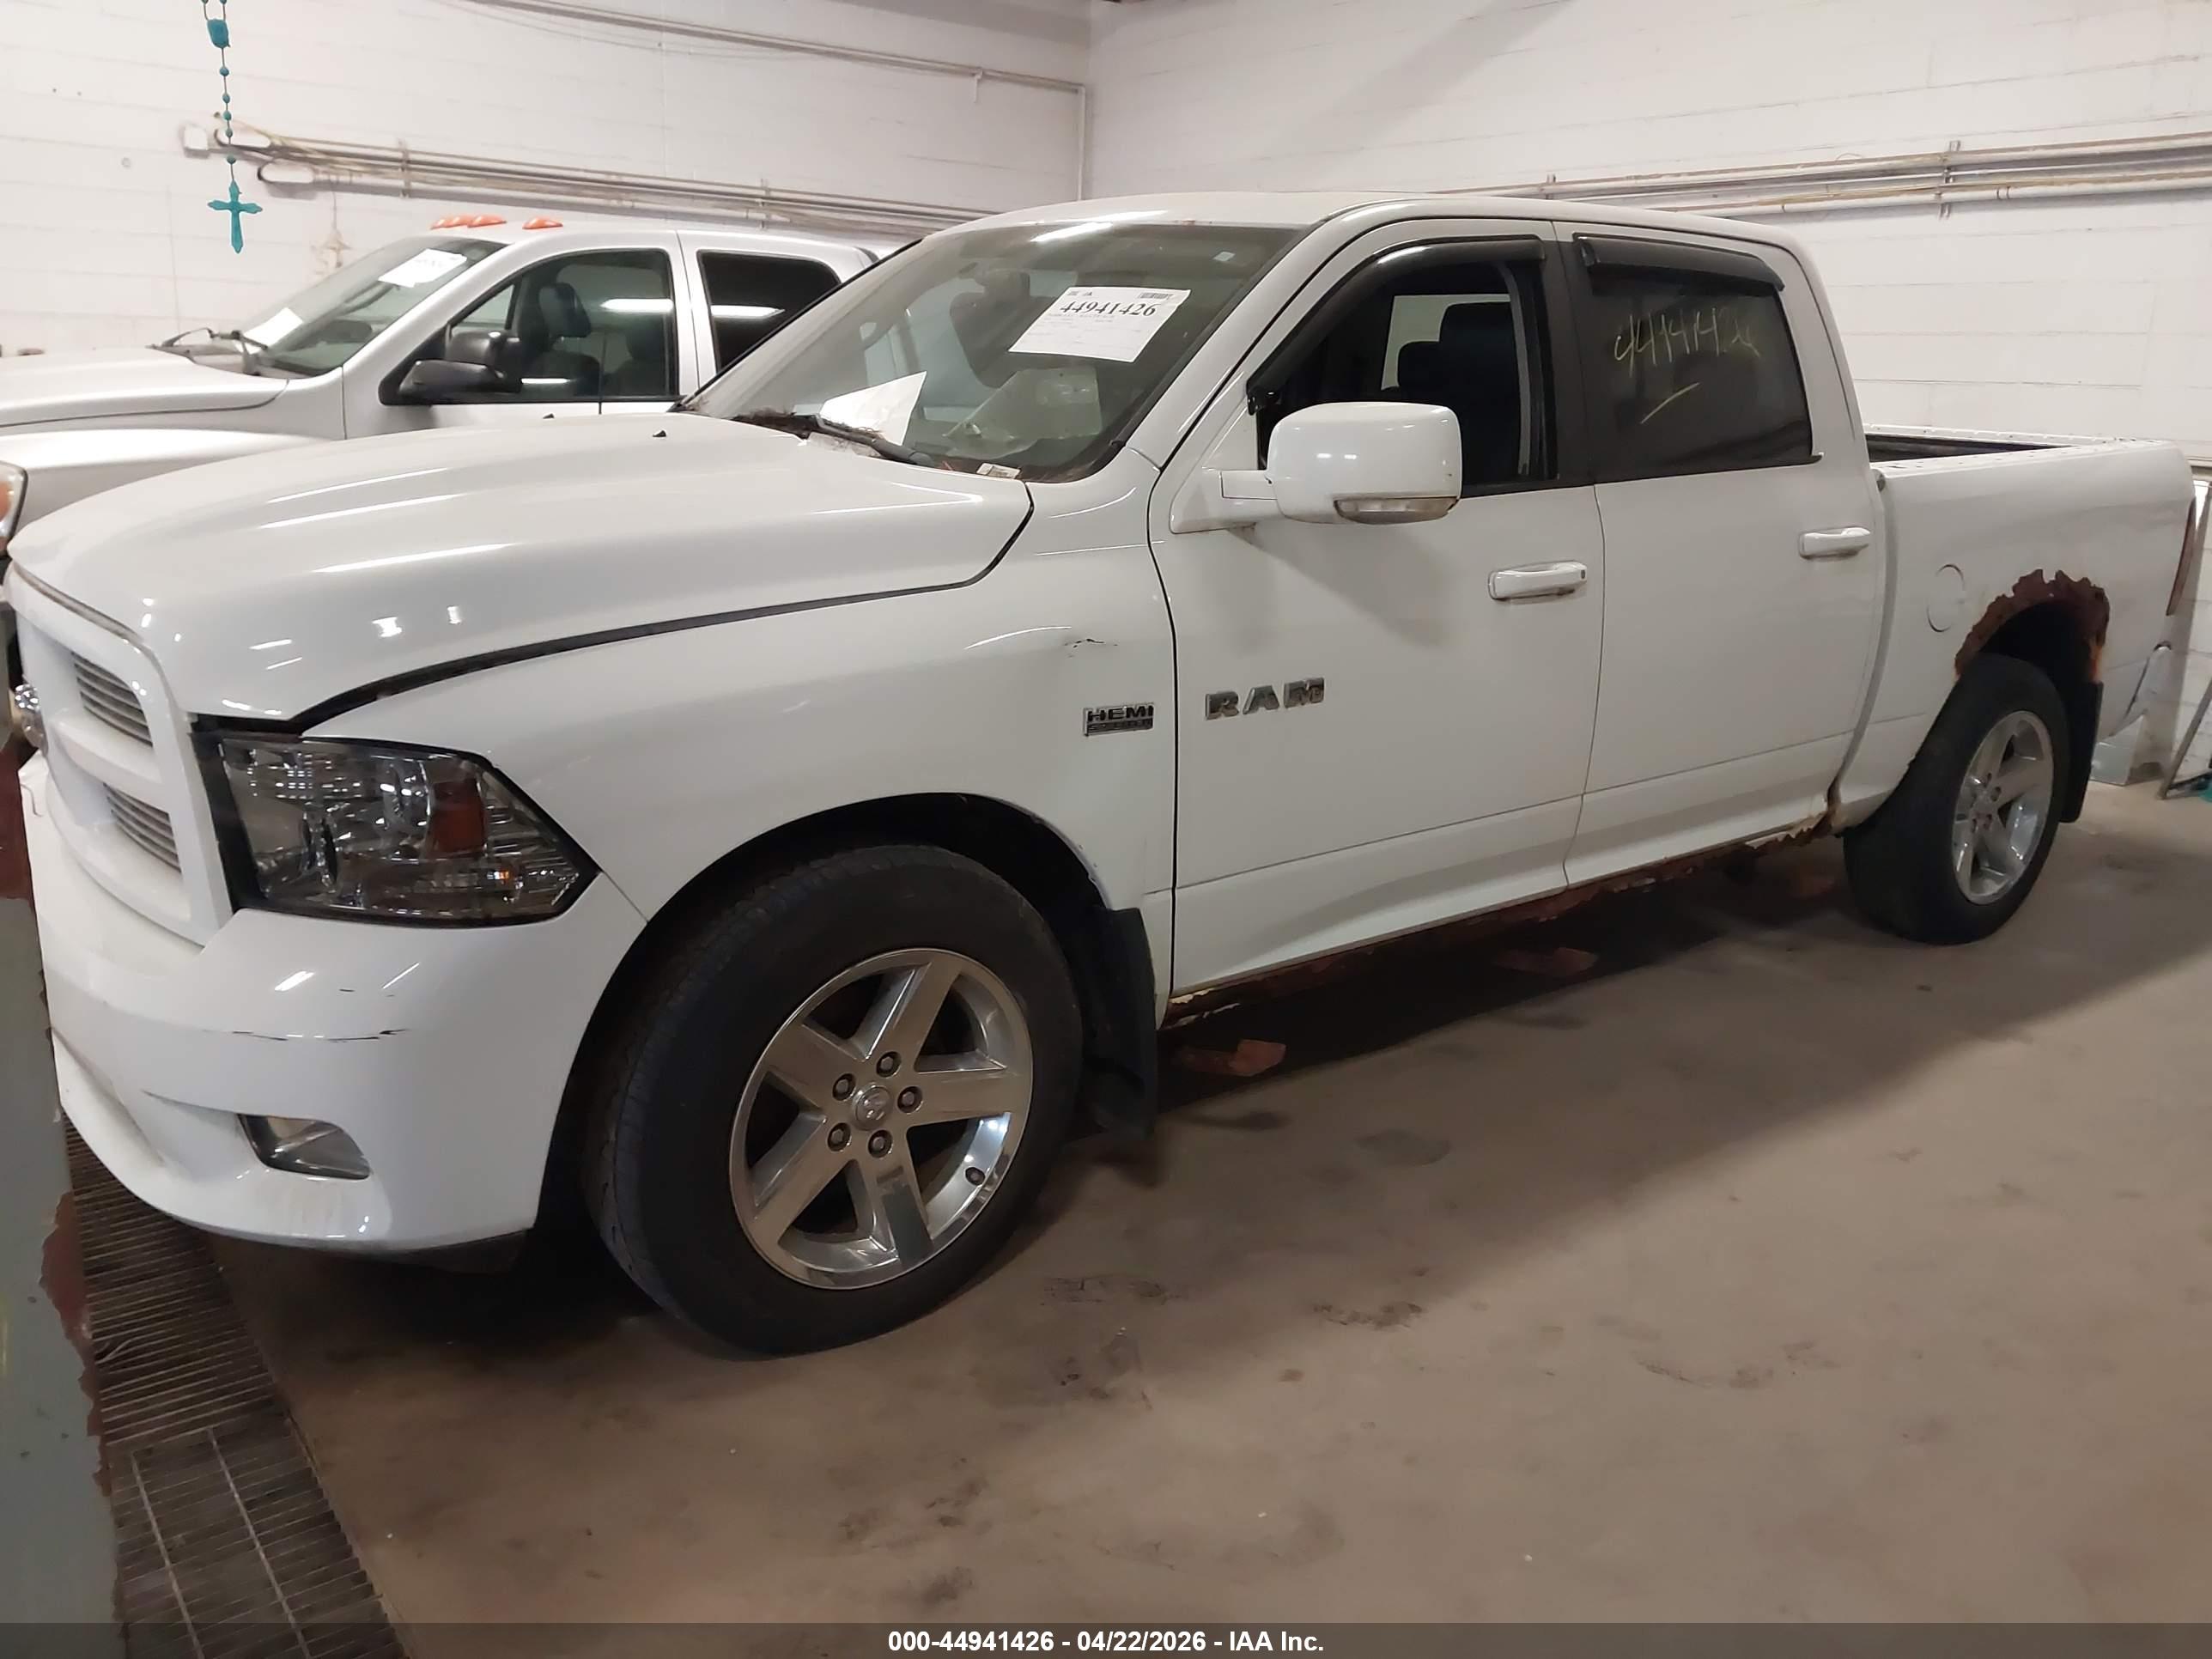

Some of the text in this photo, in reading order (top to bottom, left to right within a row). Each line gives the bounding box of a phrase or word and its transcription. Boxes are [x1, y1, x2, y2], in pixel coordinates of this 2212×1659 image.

[1059, 301, 1161, 317] 44941426
[1205, 677, 1325, 720] RAM
[1087, 705, 1154, 721] HEMI
